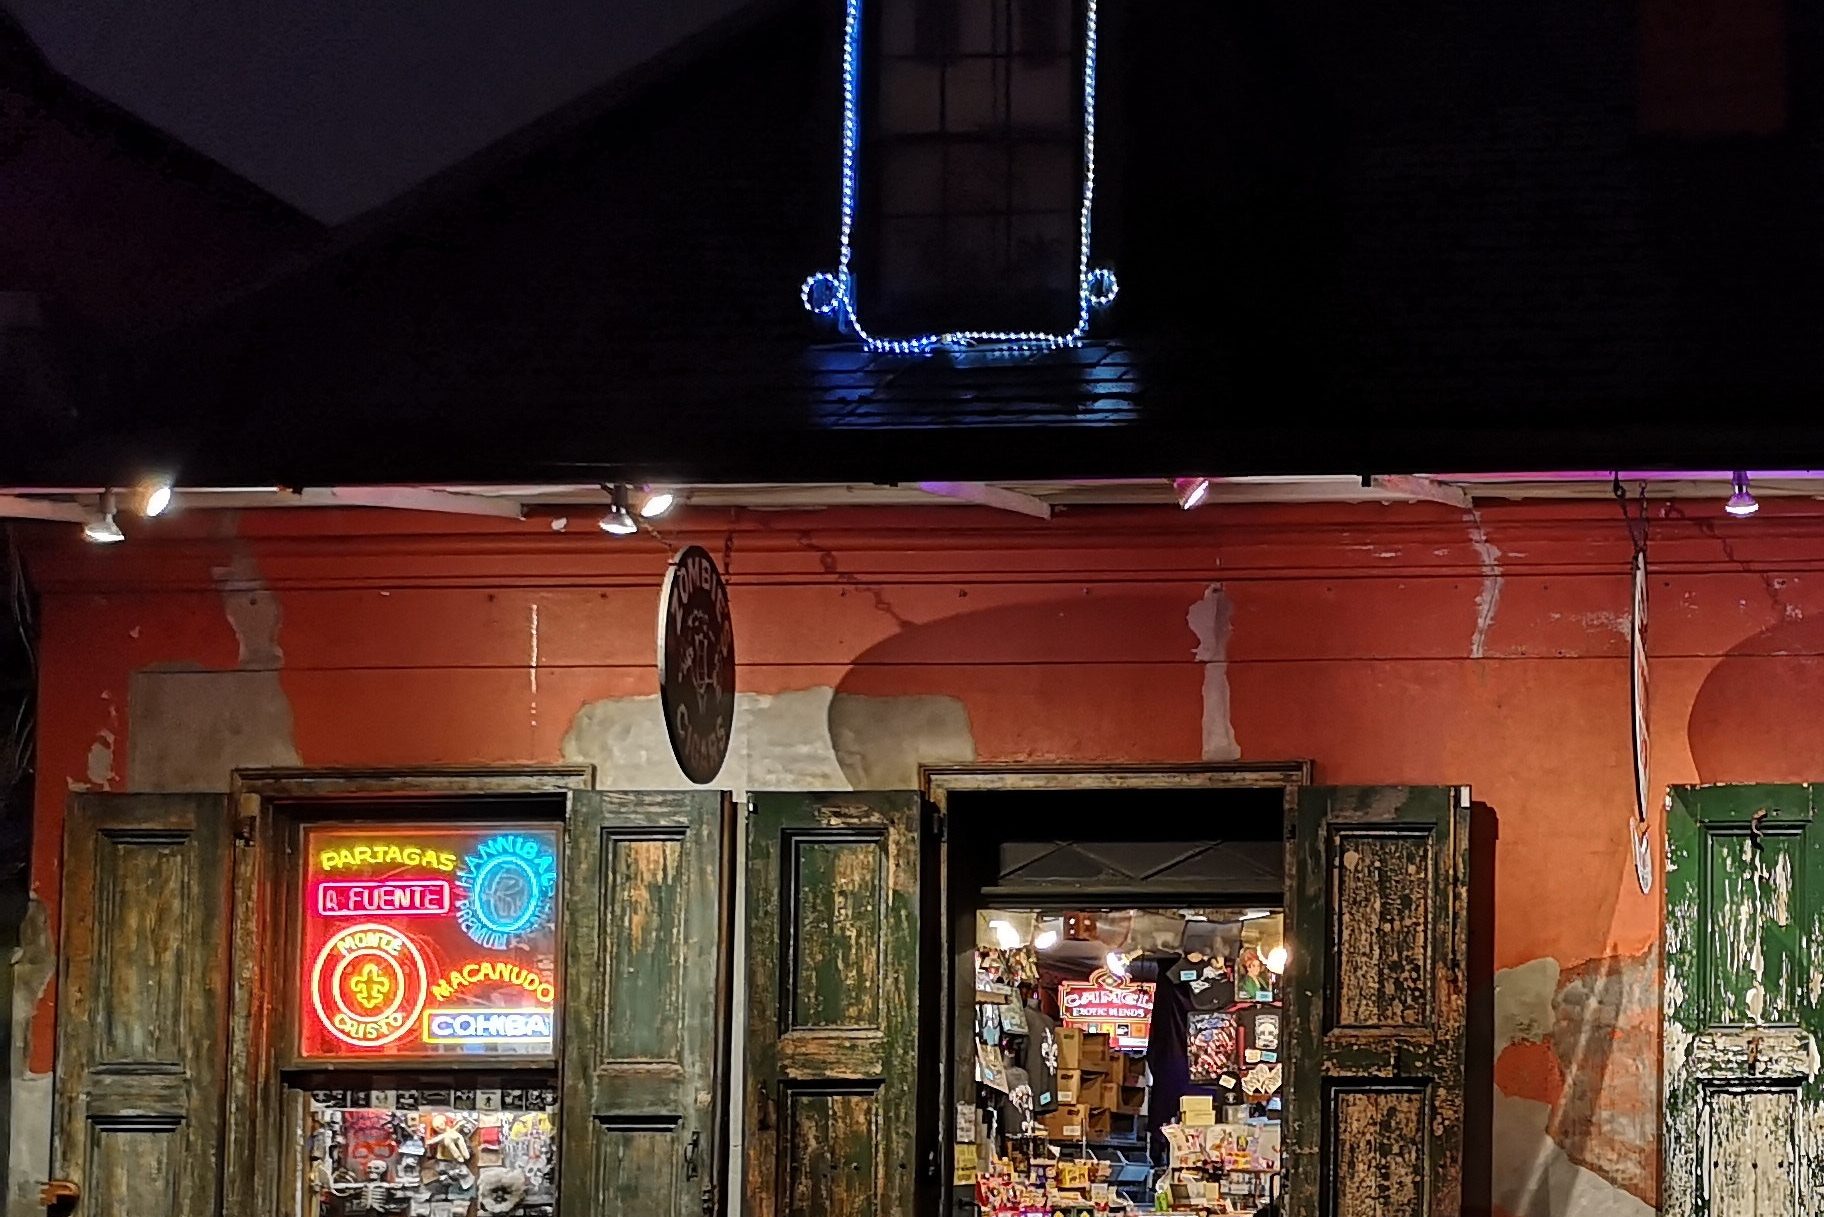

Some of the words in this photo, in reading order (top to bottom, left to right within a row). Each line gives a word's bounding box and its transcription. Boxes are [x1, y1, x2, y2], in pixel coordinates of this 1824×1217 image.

[676, 703, 726, 767] CIGARS
[321, 846, 457, 871] PARTAGAS
[455, 835, 557, 889] HANNIBAL
[348, 886, 440, 911] FUENTE
[455, 899, 508, 951] PREMIUM
[336, 931, 404, 956] MONTE
[431, 962, 555, 1003] MACANUDO
[1064, 990, 1154, 1010] CAMEL
[1072, 1007, 1107, 1017] EXOTIC
[1108, 1007, 1145, 1018] BLENDS
[333, 1012, 404, 1039] CRISTO
[431, 1014, 551, 1038] COHIBA
